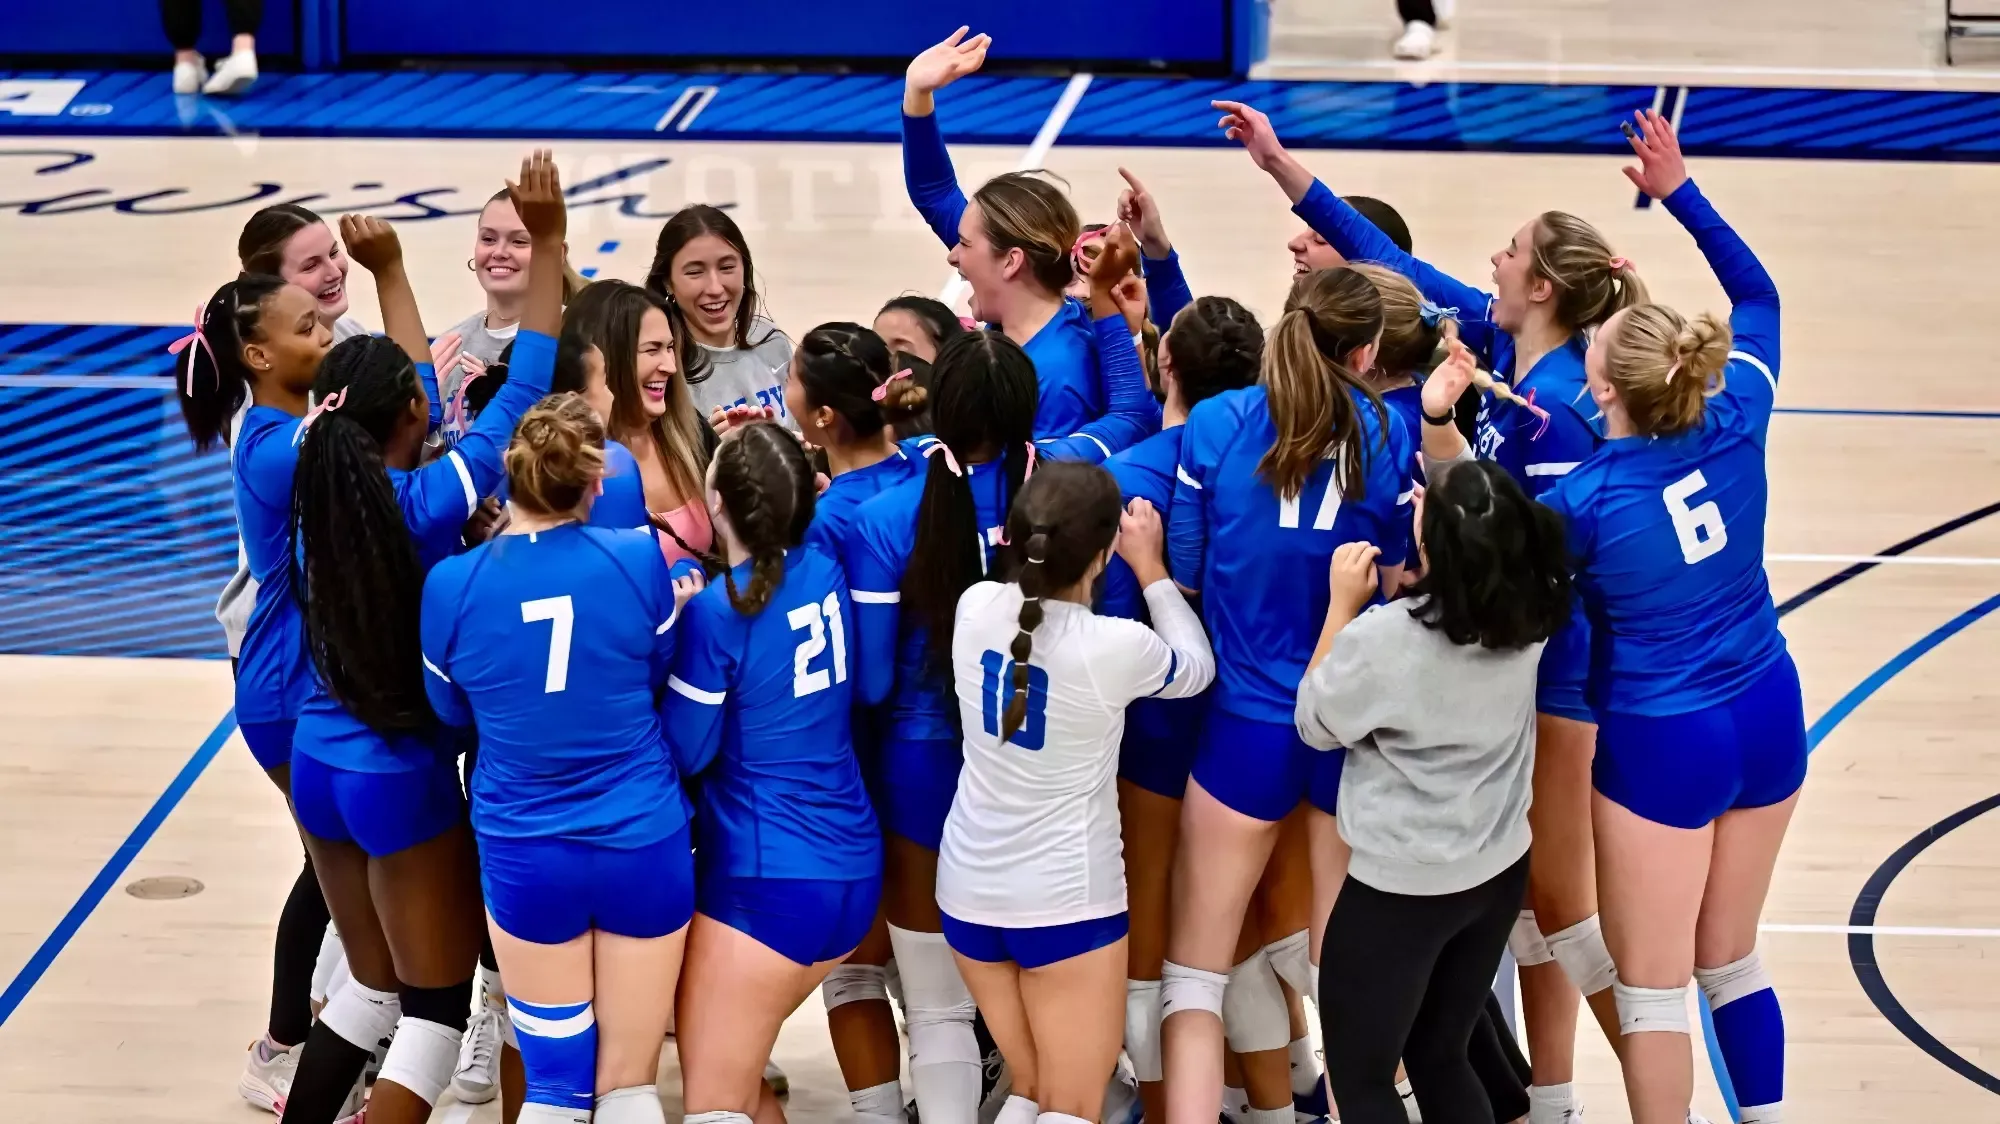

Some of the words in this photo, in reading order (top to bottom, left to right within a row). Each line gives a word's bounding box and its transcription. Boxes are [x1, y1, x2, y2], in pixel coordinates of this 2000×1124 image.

[1662, 468, 1728, 565] 6
[520, 594, 574, 694] 7
[786, 591, 847, 699] 21
